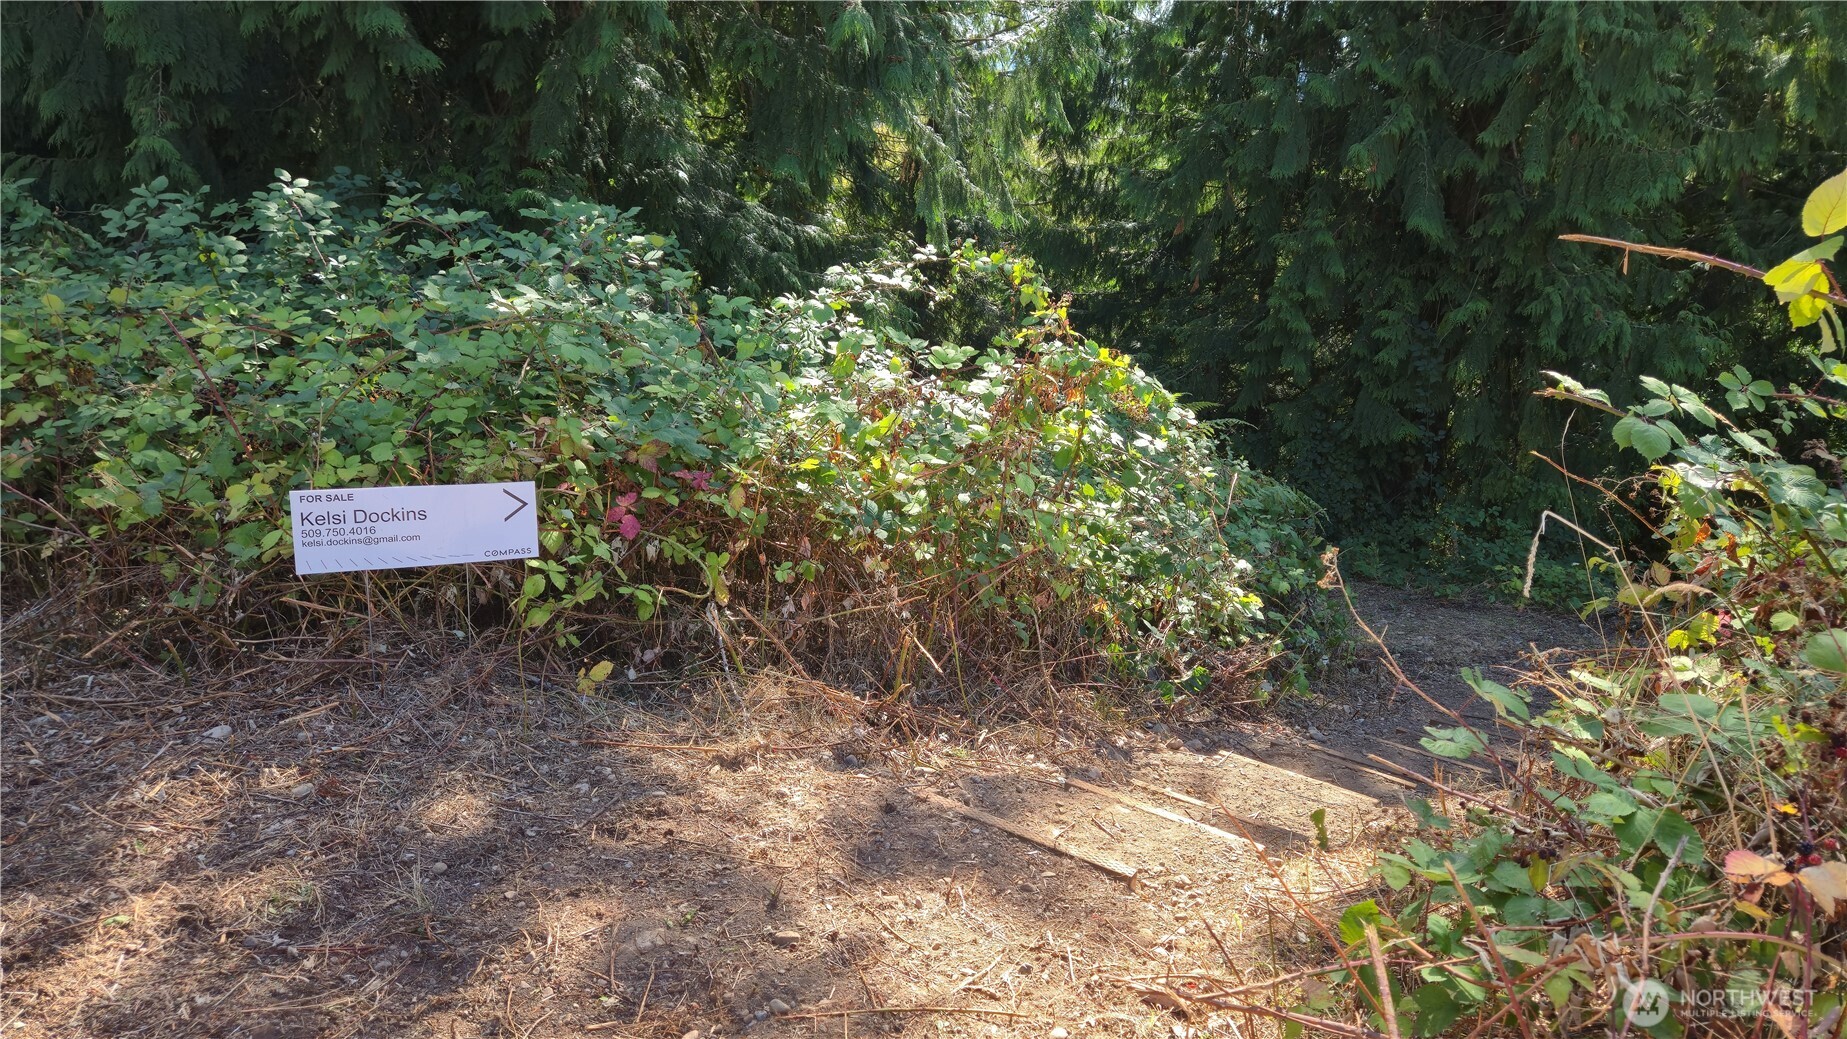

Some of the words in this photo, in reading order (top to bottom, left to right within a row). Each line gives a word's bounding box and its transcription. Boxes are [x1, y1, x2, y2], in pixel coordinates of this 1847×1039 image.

[299, 494, 322, 503] FOR
[325, 493, 354, 502] SALE
[300, 510, 346, 526] Kelsi
[353, 507, 427, 524] Dockins
[301, 526, 376, 538] 509.750.4016
[302, 534, 421, 547] kelsi.dockins@gmail.com
[484, 547, 532, 557] COMPASS
